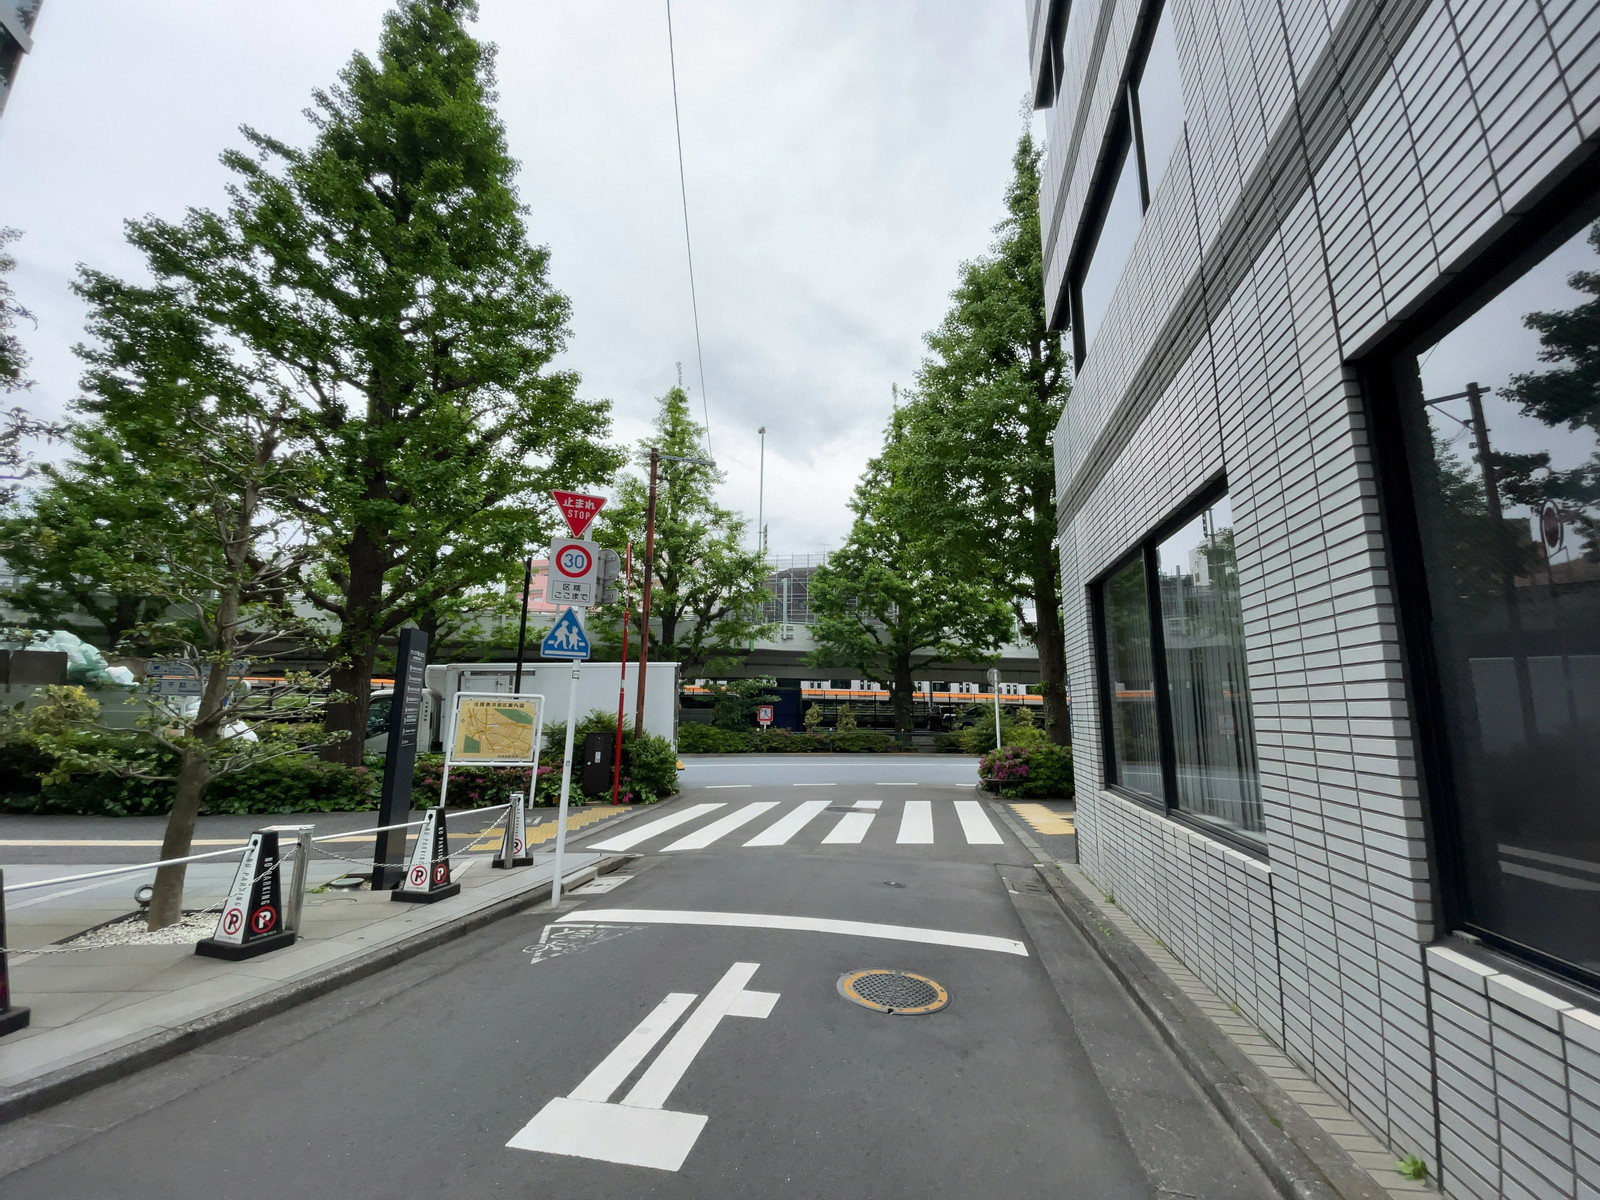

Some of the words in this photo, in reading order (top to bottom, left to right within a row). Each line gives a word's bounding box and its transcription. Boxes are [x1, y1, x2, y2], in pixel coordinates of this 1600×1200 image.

[563, 497, 596, 510] 止まれ
[567, 509, 591, 520] STOP
[564, 553, 585, 569] 30
[554, 591, 588, 601] ここまで
[264, 857, 273, 868] NO
